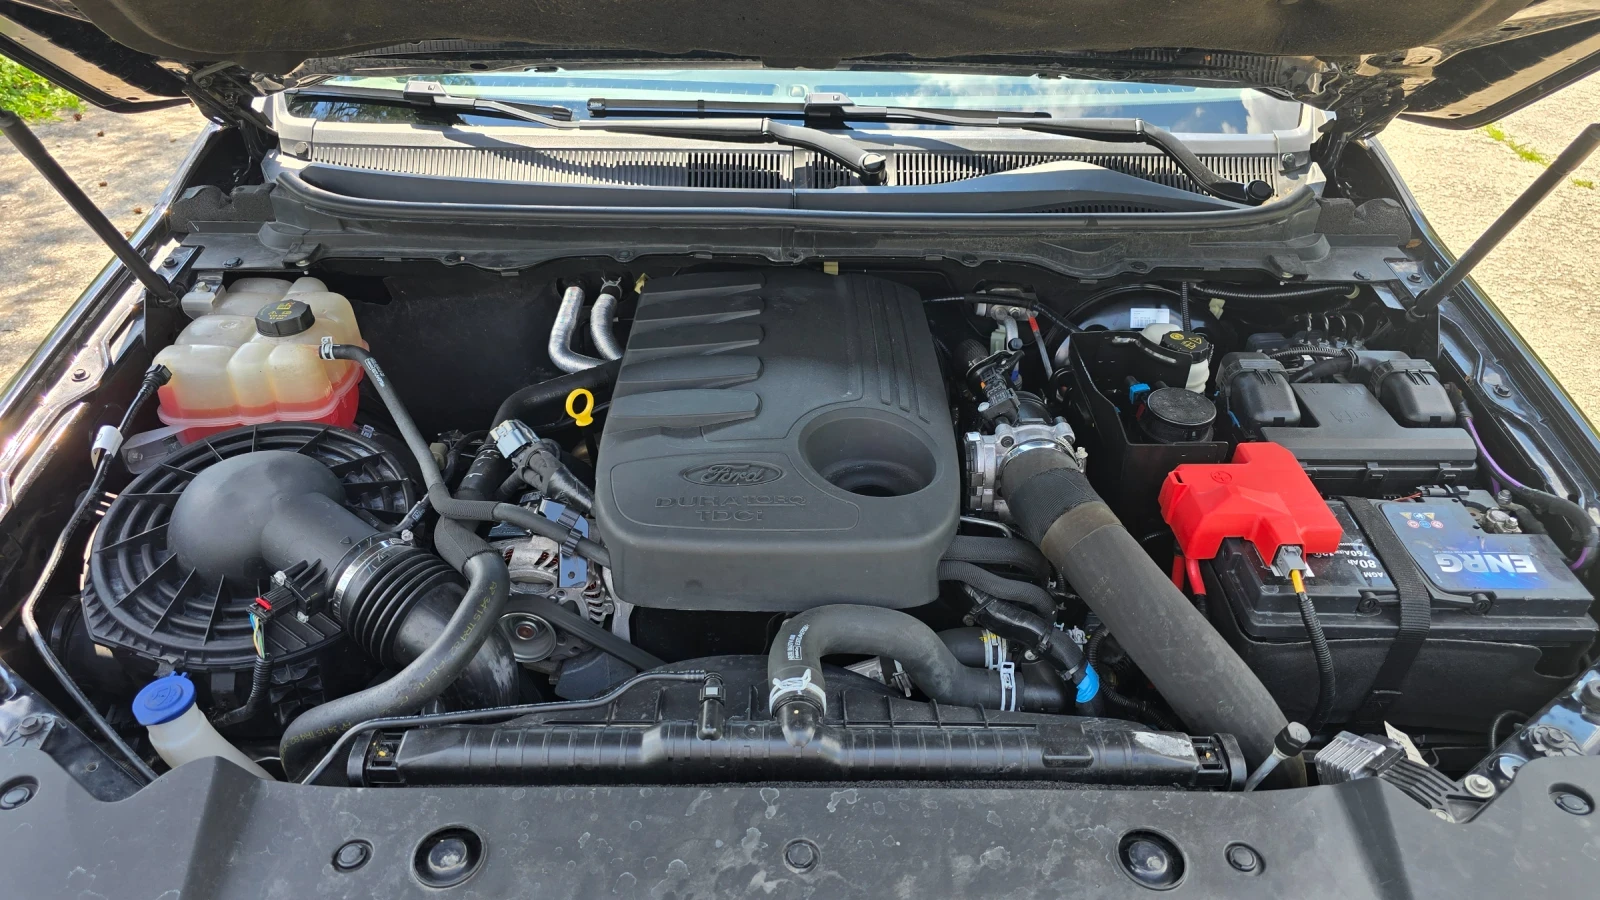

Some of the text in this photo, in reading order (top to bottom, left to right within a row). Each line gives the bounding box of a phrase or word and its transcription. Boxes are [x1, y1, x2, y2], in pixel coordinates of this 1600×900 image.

[700, 463, 765, 483] Ford
[655, 495, 807, 508] DURATORQ
[1434, 553, 1538, 573] ENRG
